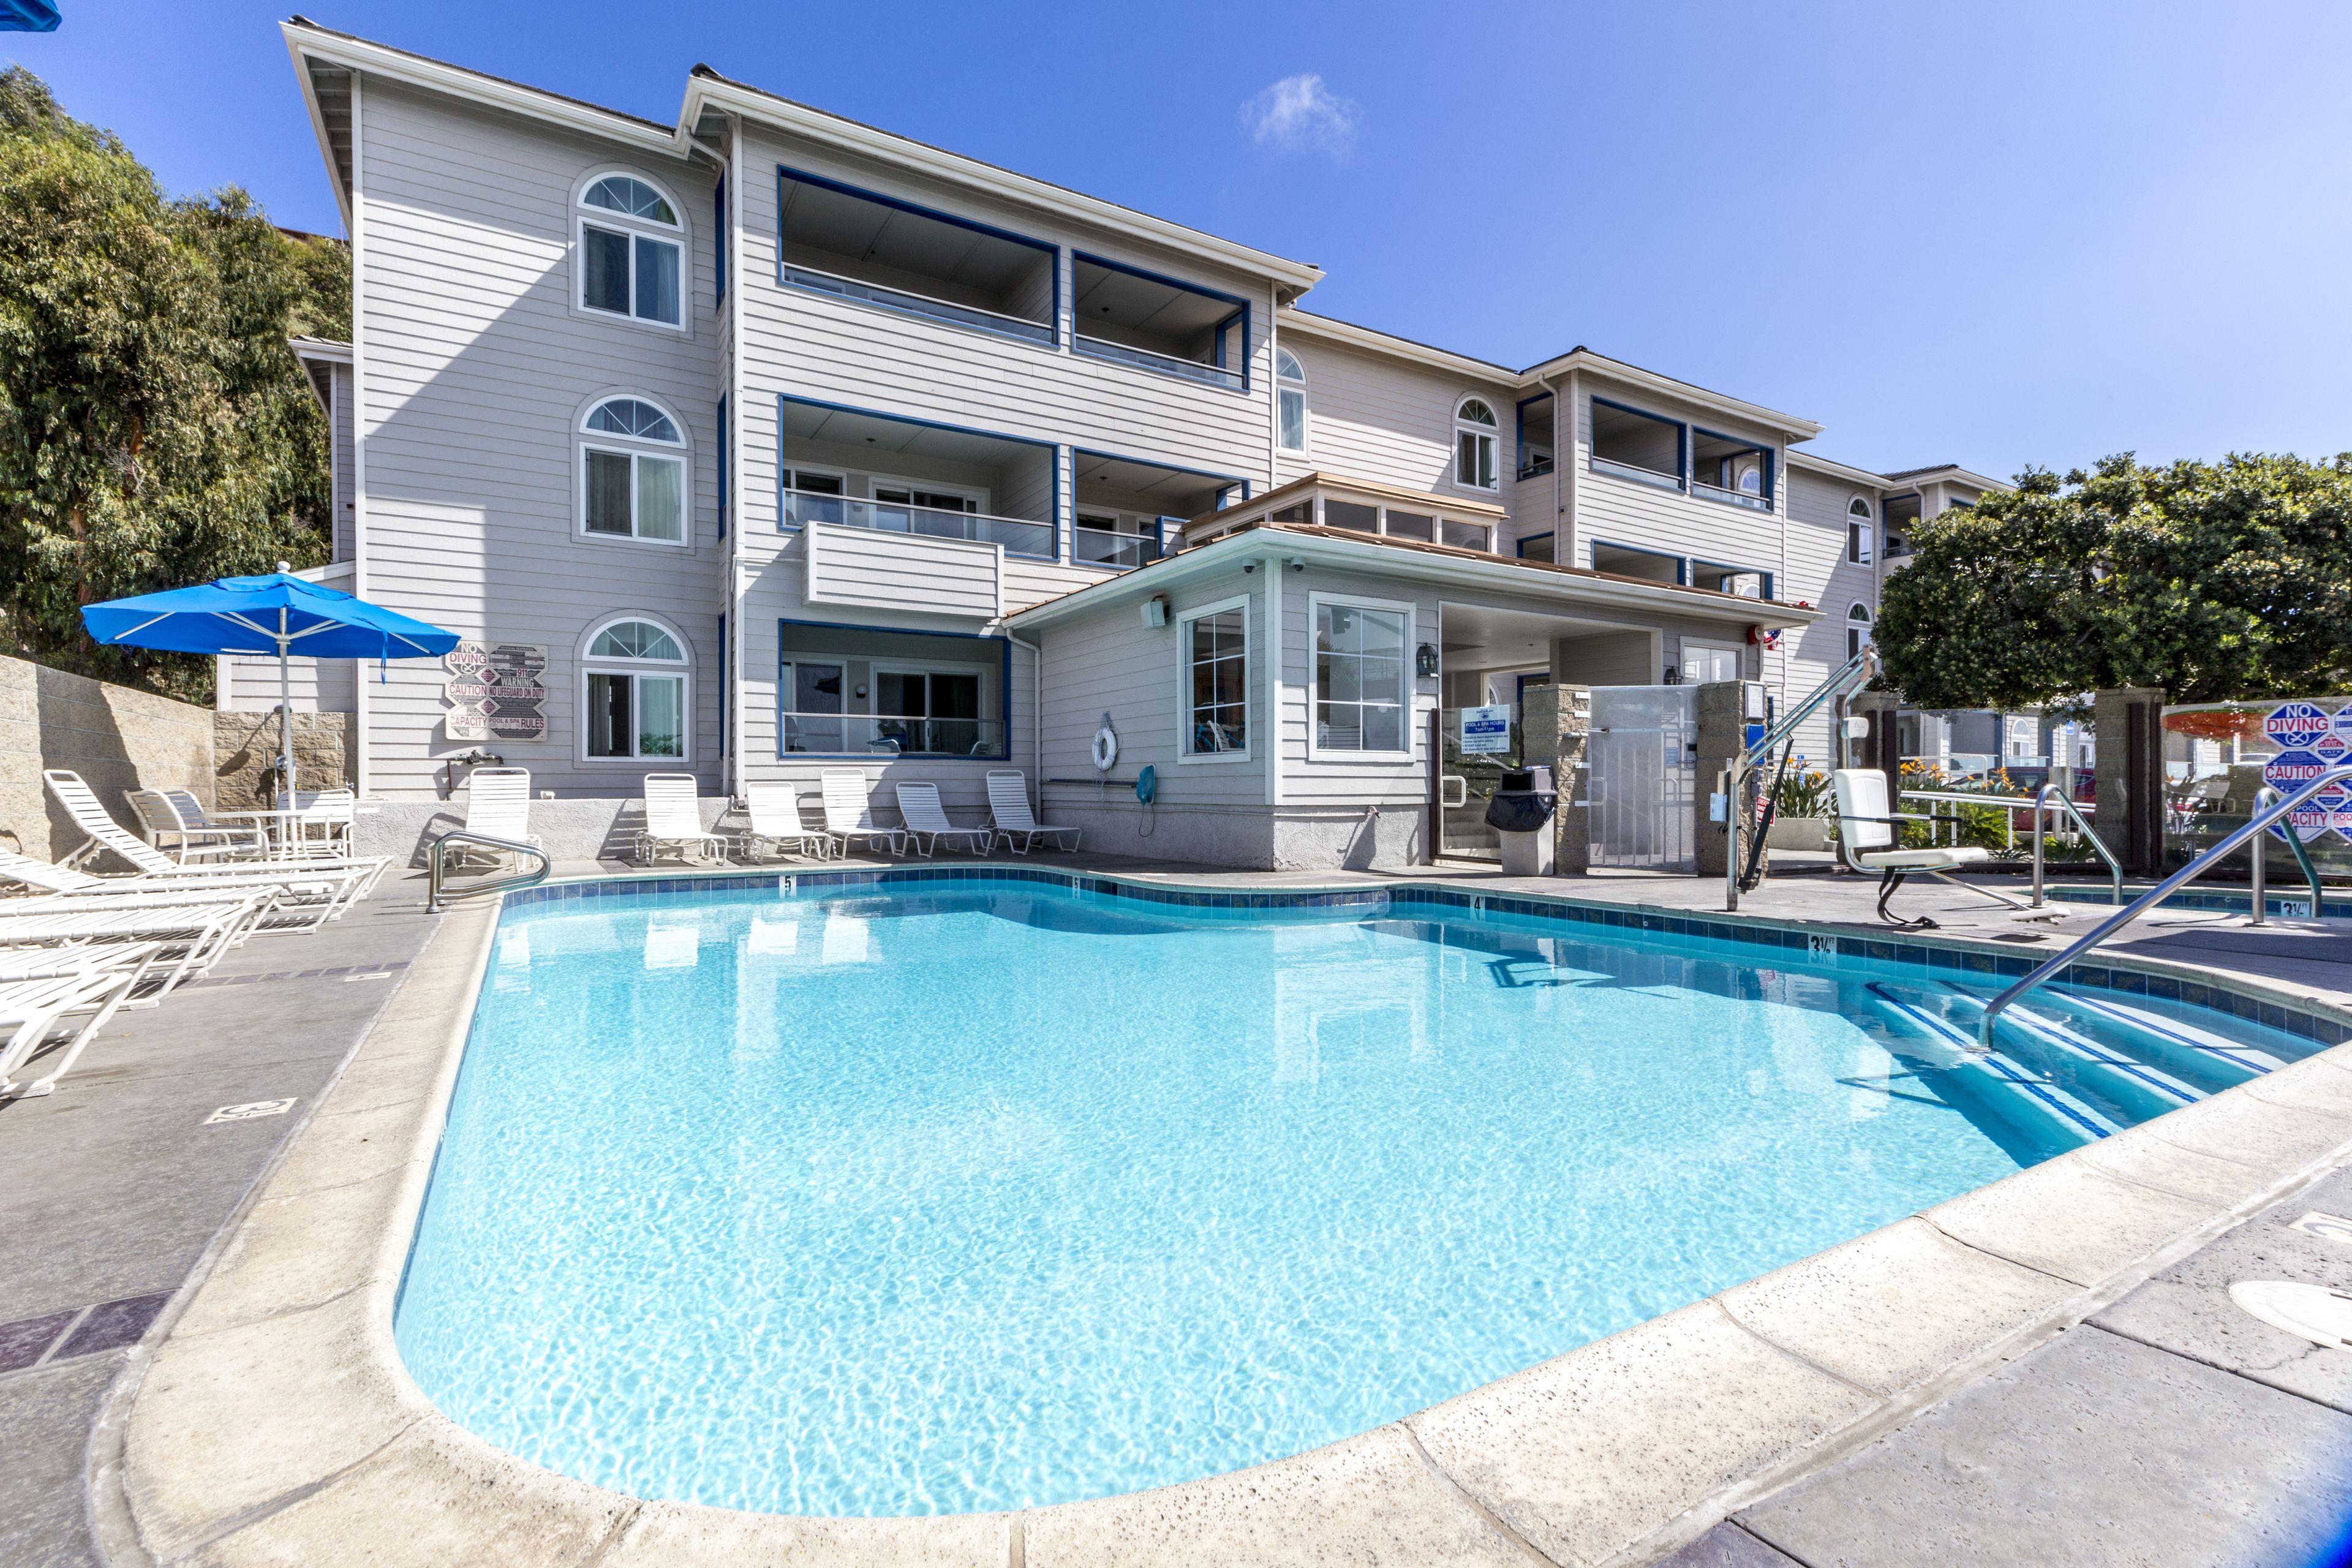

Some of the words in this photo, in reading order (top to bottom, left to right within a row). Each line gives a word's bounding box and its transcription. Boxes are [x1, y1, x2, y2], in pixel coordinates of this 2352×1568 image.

[461, 644, 478, 654] NO
[450, 653, 487, 664] DIVING
[517, 668, 527, 677] 911
[500, 677, 535, 688] WARNING
[449, 684, 487, 695] CAUTION
[489, 687, 497, 696] NO
[497, 687, 523, 697] LIFEGUARD
[524, 688, 532, 698] ON
[532, 688, 545, 698] DUTY
[2286, 704, 2311, 718] NO
[450, 716, 488, 727] CAPACITY
[521, 718, 545, 728] RULES
[2267, 717, 2328, 732] DIVING
[2266, 765, 2326, 779] CAUTION
[2285, 812, 2328, 826] ACITY
[785, 875, 791, 888] 5
[1474, 896, 1481, 909] 4
